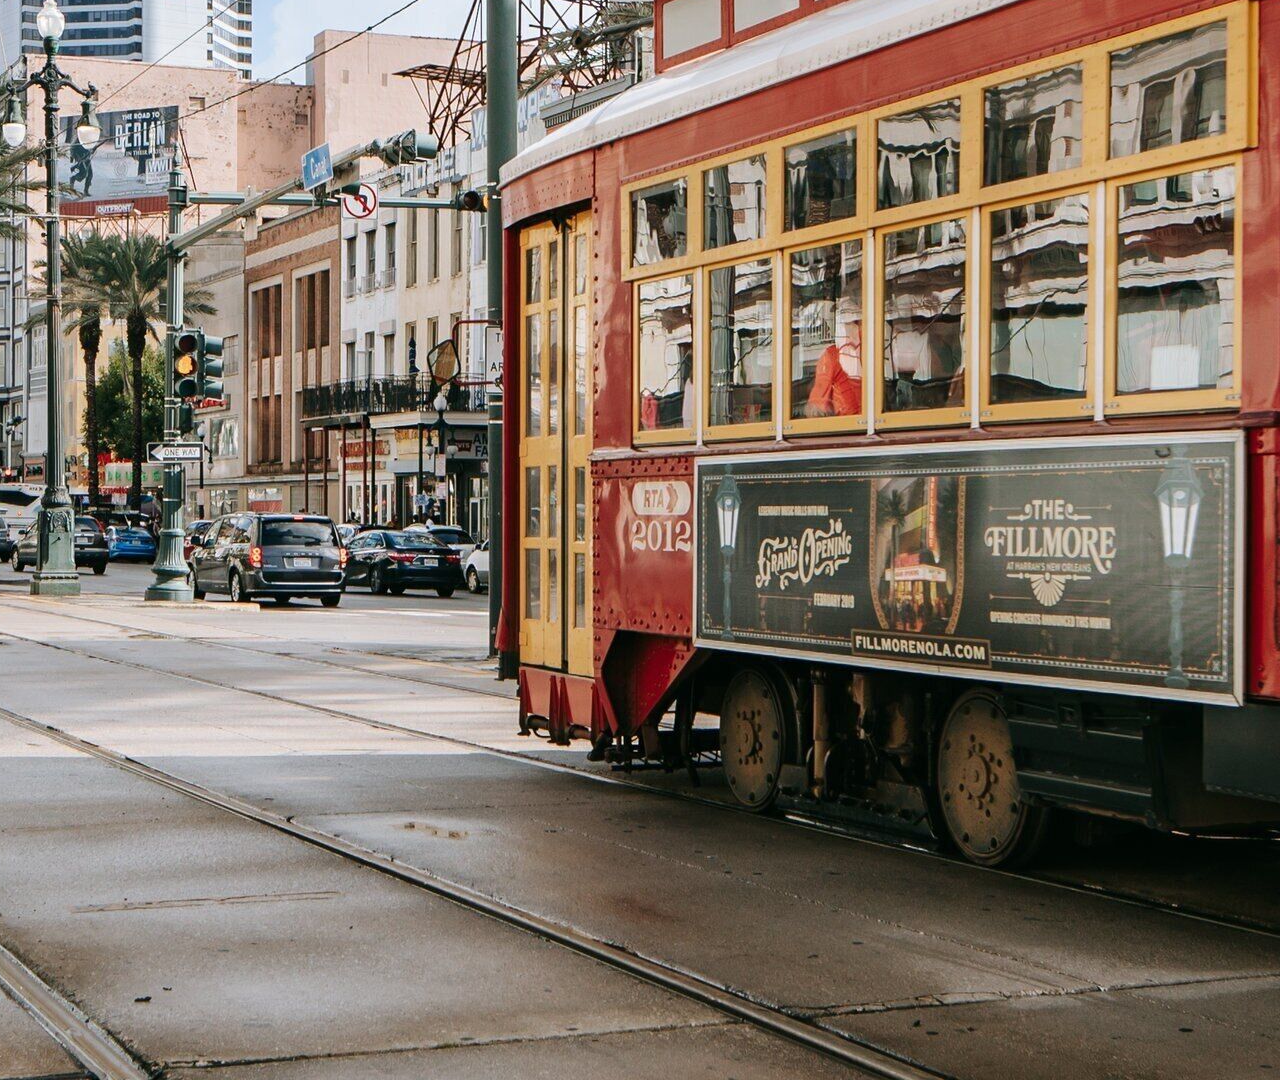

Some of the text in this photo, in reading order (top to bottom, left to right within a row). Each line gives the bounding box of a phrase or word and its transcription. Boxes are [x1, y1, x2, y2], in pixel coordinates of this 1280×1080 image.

[134, 112, 150, 120] ROAD
[152, 111, 160, 119] TO
[97, 204, 132, 214] OUTFRONT
[164, 448, 198, 456] ONE WAY
[643, 490, 664, 508] RTA
[1032, 499, 1065, 520] THE
[632, 520, 692, 552] 2012
[756, 522, 852, 588] GRAND OPENING
[984, 526, 1117, 574] FILLMORE
[855, 635, 986, 660] FILLMORENOLA.COM
